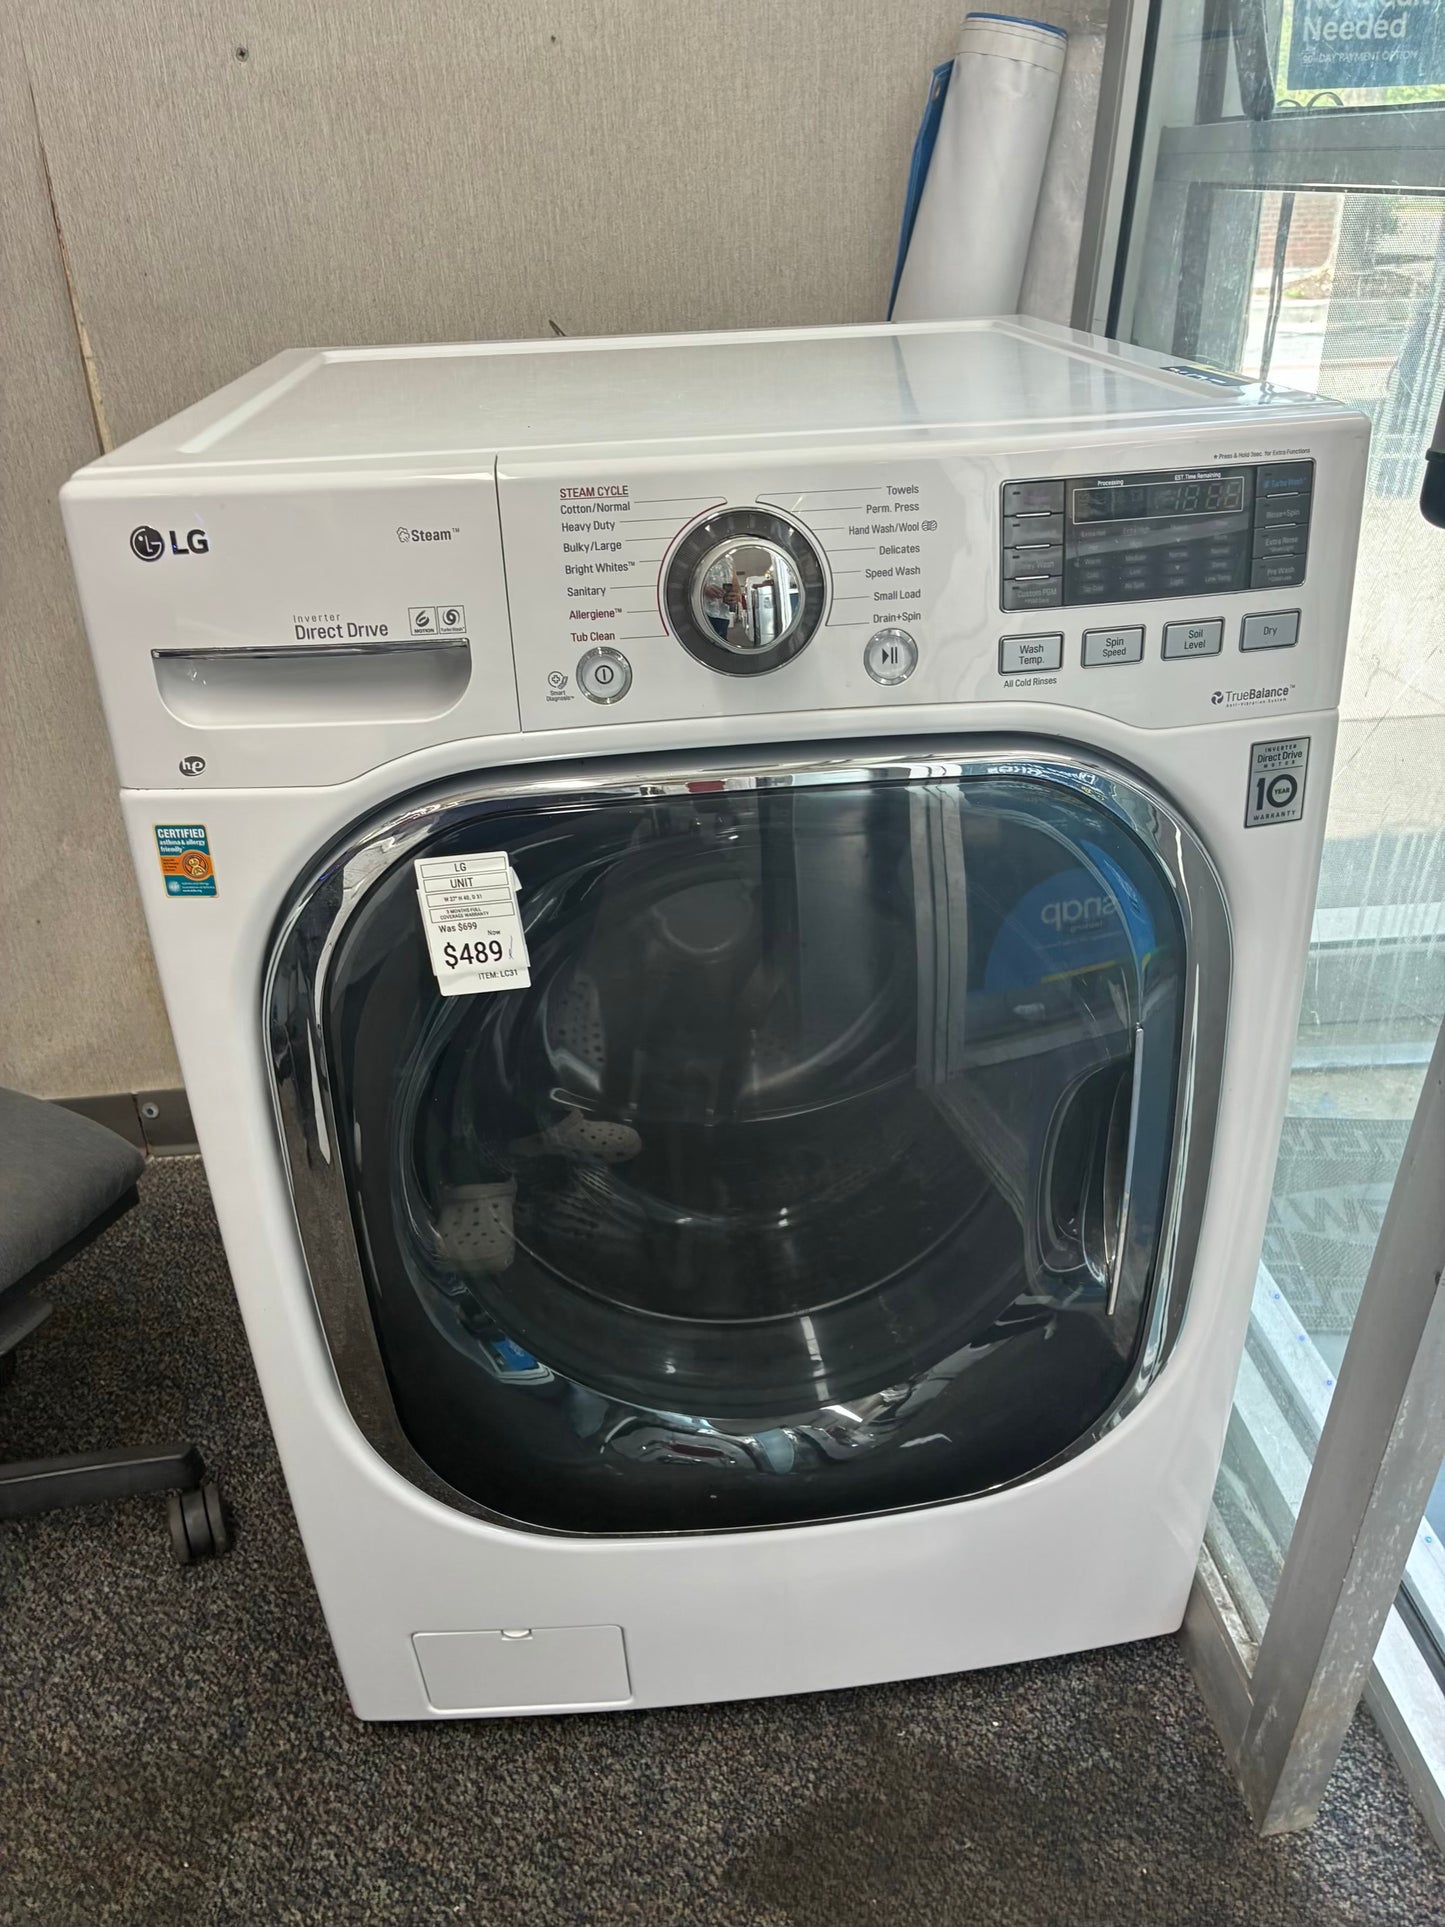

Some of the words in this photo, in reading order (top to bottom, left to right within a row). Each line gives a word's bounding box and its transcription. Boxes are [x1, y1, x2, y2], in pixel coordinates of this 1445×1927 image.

[1303, 11, 1407, 41] Needed
[560, 487, 595, 499] STEAM
[598, 485, 629, 497] CYCLE
[886, 485, 919, 495] Towels
[560, 501, 631, 514] Cotton/Normal
[866, 504, 892, 514] Perm.
[894, 502, 919, 512] Press
[562, 522, 591, 533] Heavy
[594, 521, 616, 532] Duty
[848, 525, 870, 535] Hand
[871, 522, 919, 534] Wash/Wool
[169, 529, 209, 555] LG
[563, 541, 622, 554] Bulky/Large
[879, 545, 920, 556] Delicates
[565, 563, 594, 576] Bright
[865, 568, 893, 580] Speed
[895, 566, 920, 576] Wash
[567, 586, 606, 598] Sanitary
[874, 591, 898, 601] Small
[900, 589, 921, 599] Load
[293, 613, 341, 623] Inverter
[873, 611, 921, 624] Drain+Spin
[295, 624, 344, 640] Direct
[347, 622, 389, 638] Drive
[570, 632, 588, 642] Tub
[590, 631, 615, 641] Clean
[1188, 628, 1204, 640] Soil
[1264, 625, 1278, 636] Dry
[1105, 637, 1124, 648] Spin
[1184, 638, 1206, 650] Level
[1019, 644, 1044, 655] Wash
[1102, 646, 1126, 658] Speed
[1018, 654, 1044, 667] Temp.
[1004, 679, 1013, 689] All
[1014, 678, 1031, 688] Cold
[1032, 676, 1056, 686] Rinses
[1265, 744, 1297, 752] INVERTER
[1258, 753, 1282, 763] Direct
[1283, 751, 1303, 760] Drive
[1264, 760, 1295, 768] MOTOR
[1256, 774, 1298, 810] 10
[1254, 810, 1296, 820] WARRANTY
[158, 828, 205, 839] CERTIFIED
[454, 862, 467, 872] LG
[450, 878, 474, 888] UNIT
[438, 924, 456, 933] Was
[458, 922, 478, 932] $699
[444, 940, 503, 970] $489
[478, 971, 499, 980] ITEM:
[500, 969, 518, 978] LC31
